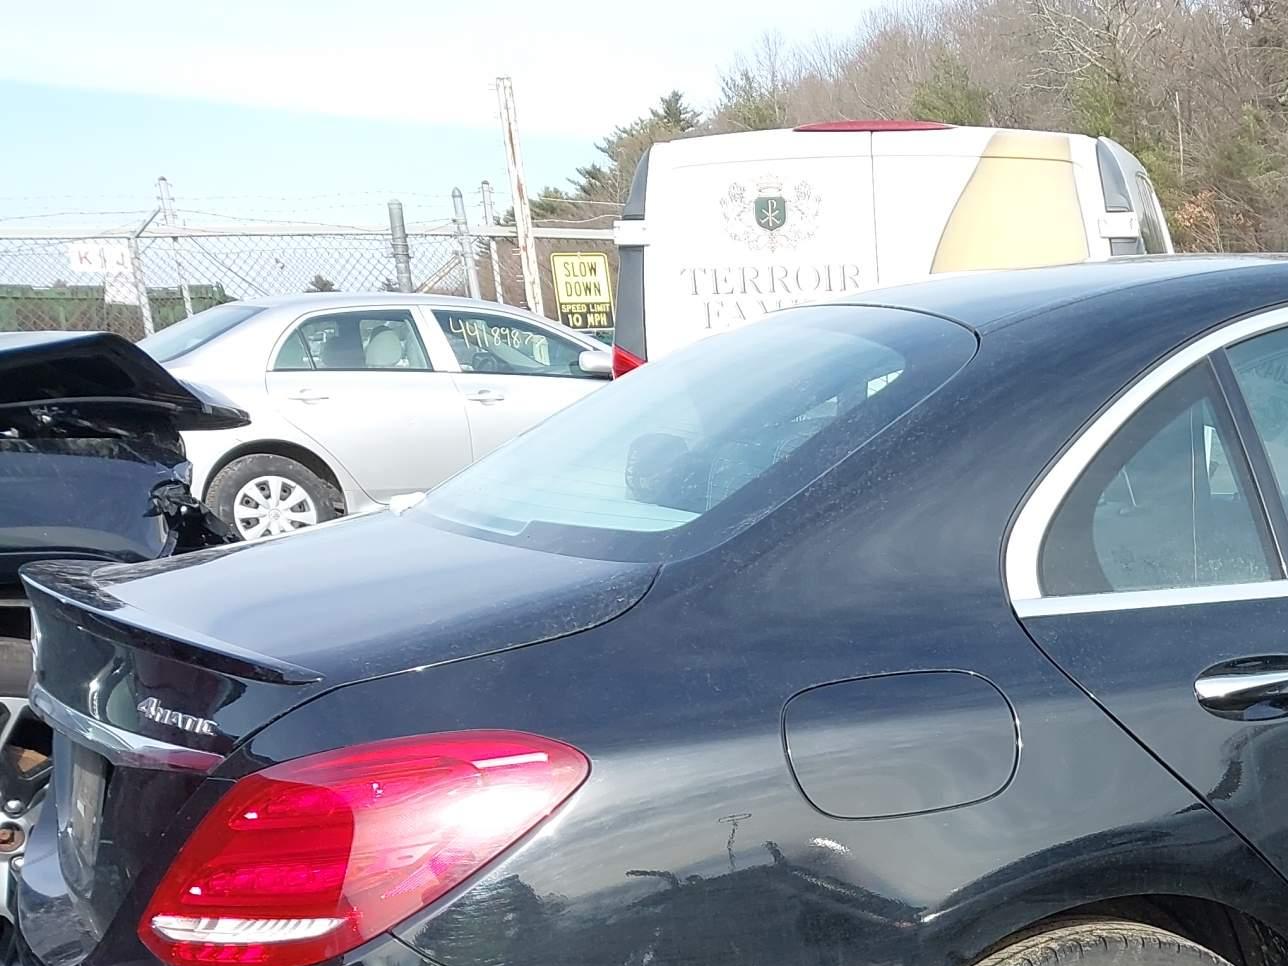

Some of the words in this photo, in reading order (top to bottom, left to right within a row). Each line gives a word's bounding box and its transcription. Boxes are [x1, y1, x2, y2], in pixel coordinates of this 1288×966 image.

[563, 261, 597, 278] SLOW
[680, 264, 861, 296] TERROIR
[565, 281, 602, 297] DOWN
[561, 304, 587, 313] SPEED
[589, 303, 611, 312] LIMIT
[567, 313, 583, 327] 10
[586, 313, 608, 327] MPH
[137, 697, 220, 736] 4MATIC
